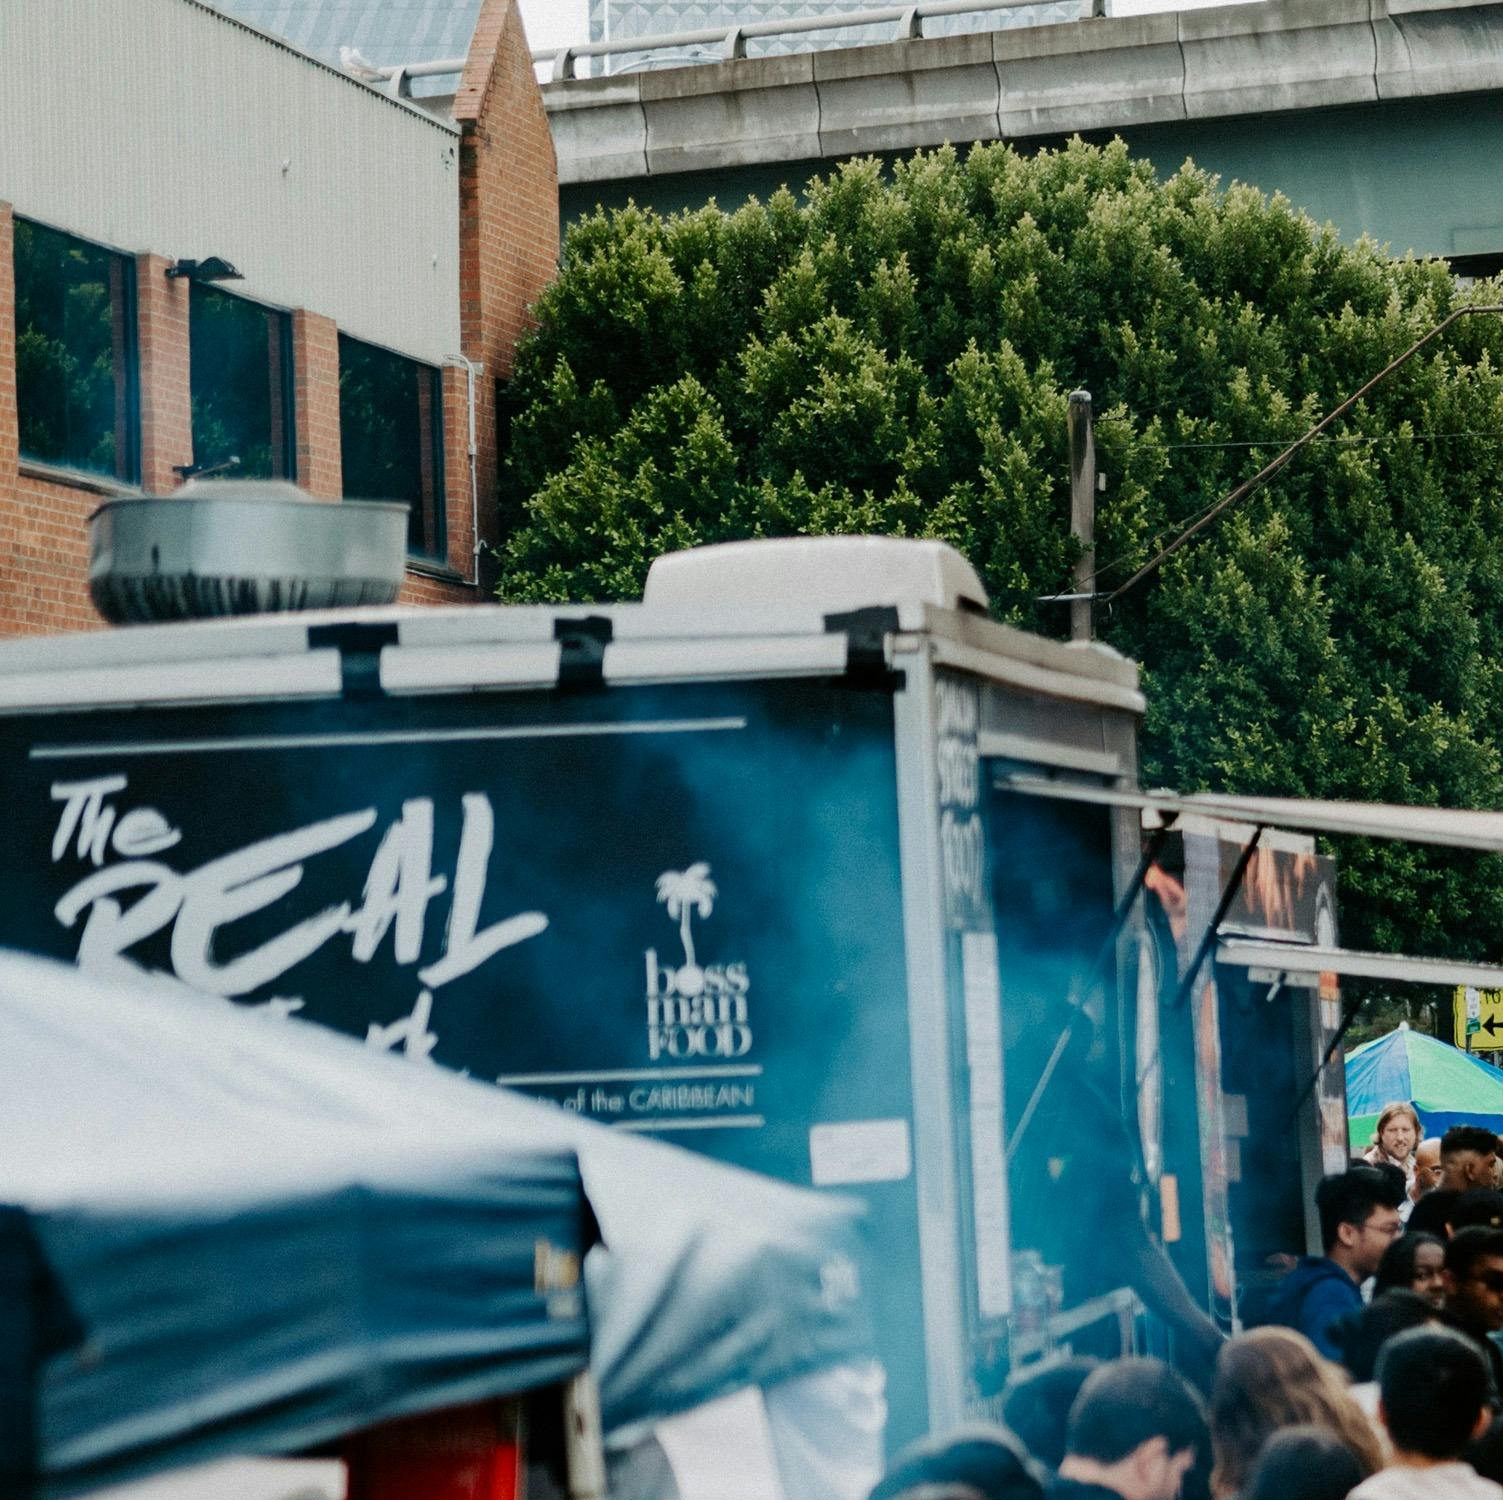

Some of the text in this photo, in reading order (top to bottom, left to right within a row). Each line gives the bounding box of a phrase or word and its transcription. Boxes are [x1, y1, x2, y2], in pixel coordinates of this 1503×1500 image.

[51, 775, 182, 865] The
[54, 792, 549, 998] REAL
[647, 993, 749, 1025] man
[591, 1087, 625, 1113] the
